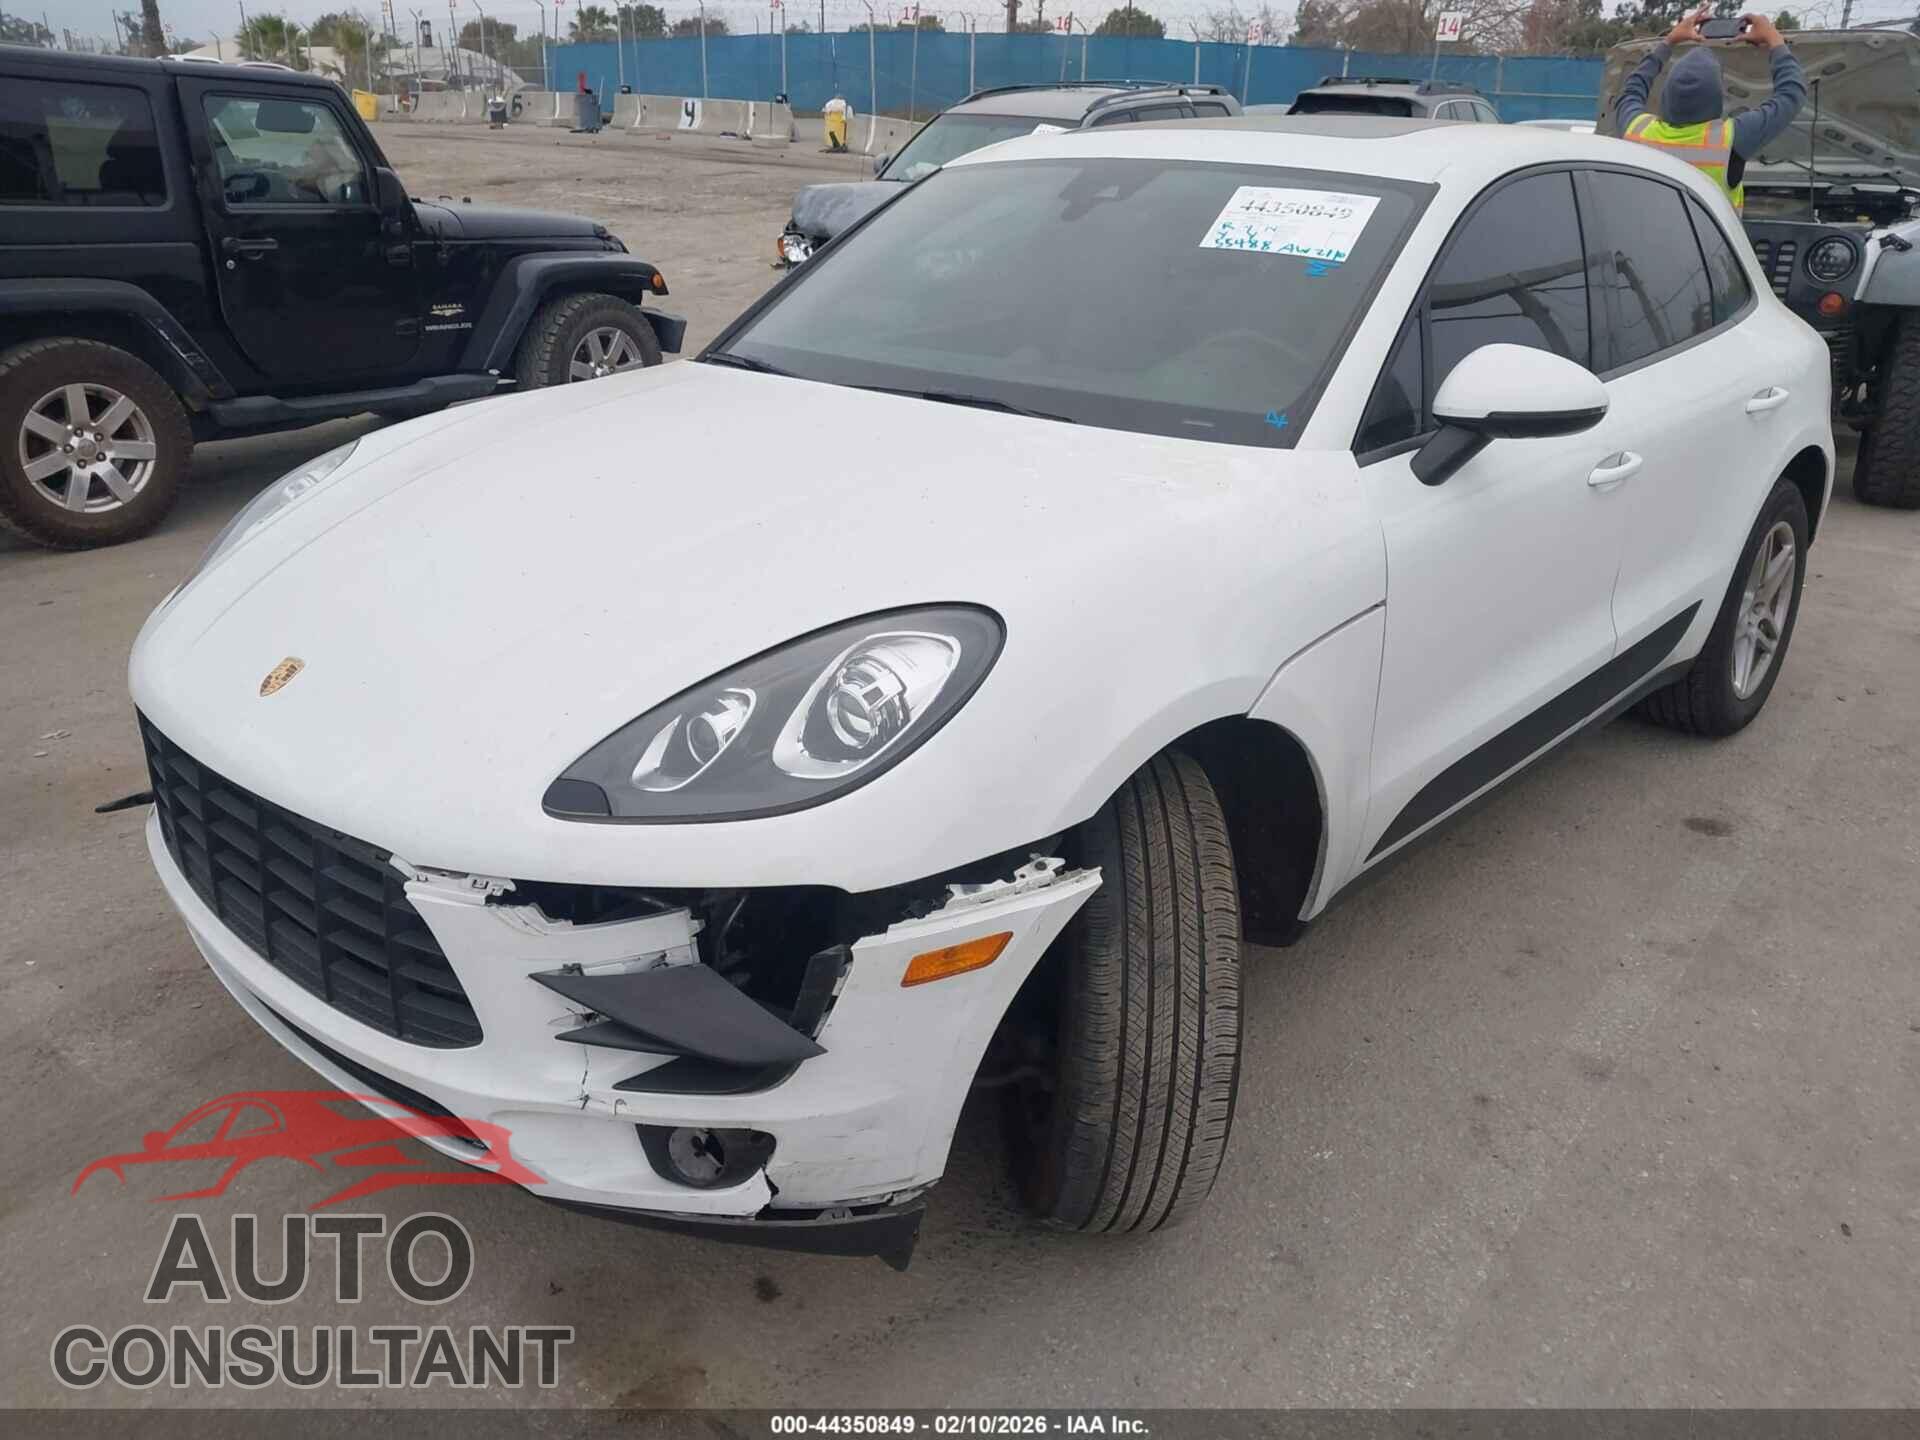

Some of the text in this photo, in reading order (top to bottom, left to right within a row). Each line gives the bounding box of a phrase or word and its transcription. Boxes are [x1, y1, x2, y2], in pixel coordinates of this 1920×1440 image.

[903, 6, 919, 20] 17
[1439, 17, 1457, 35] 14
[684, 101, 695, 127] 4
[1240, 199, 1353, 219] 44350849
